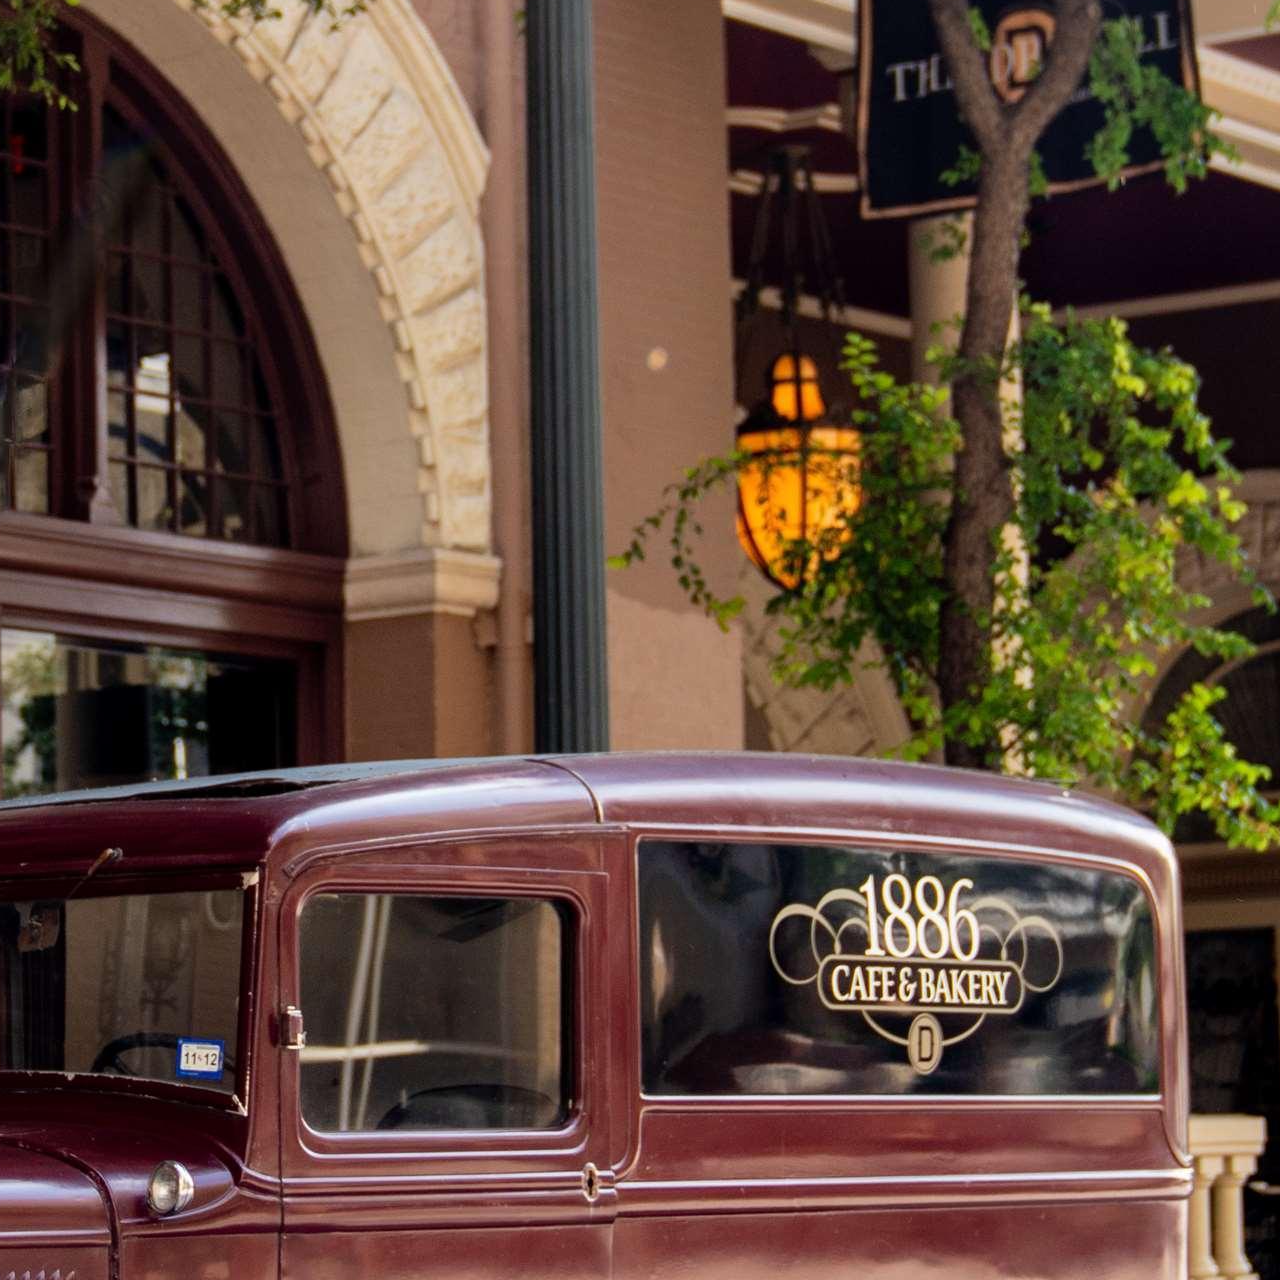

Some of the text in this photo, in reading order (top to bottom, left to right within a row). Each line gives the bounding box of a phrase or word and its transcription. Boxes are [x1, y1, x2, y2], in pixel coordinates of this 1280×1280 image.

[859, 873, 980, 962] 1886
[831, 964, 1012, 1005] CAFE & BAKERY
